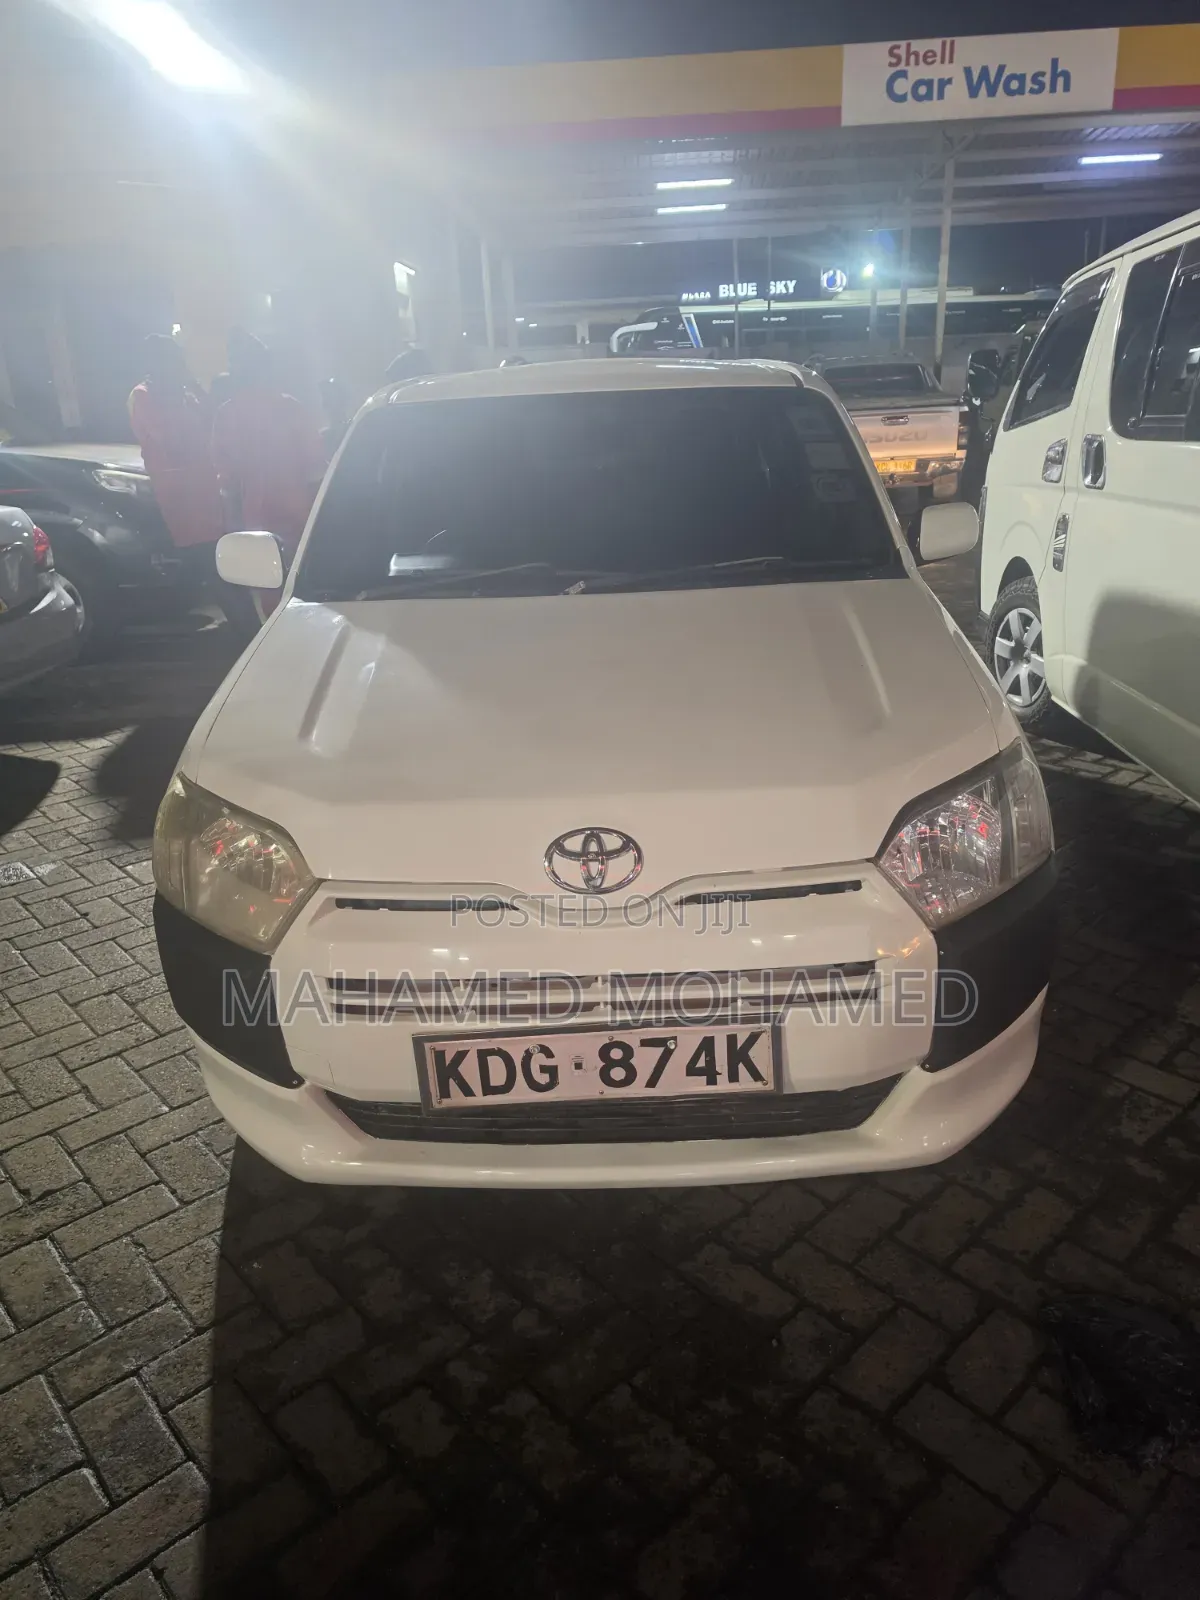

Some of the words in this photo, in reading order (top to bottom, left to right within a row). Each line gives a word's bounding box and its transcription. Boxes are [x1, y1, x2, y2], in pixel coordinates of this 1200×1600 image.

[887, 39, 956, 68] Shell
[885, 69, 953, 103] Car
[963, 57, 1072, 99] Wash
[718, 283, 758, 298] BLUE
[768, 279, 797, 295] SKY
[865, 430, 928, 444] SUZU
[433, 1043, 560, 1098] KDG
[597, 1031, 767, 1089] 874K
